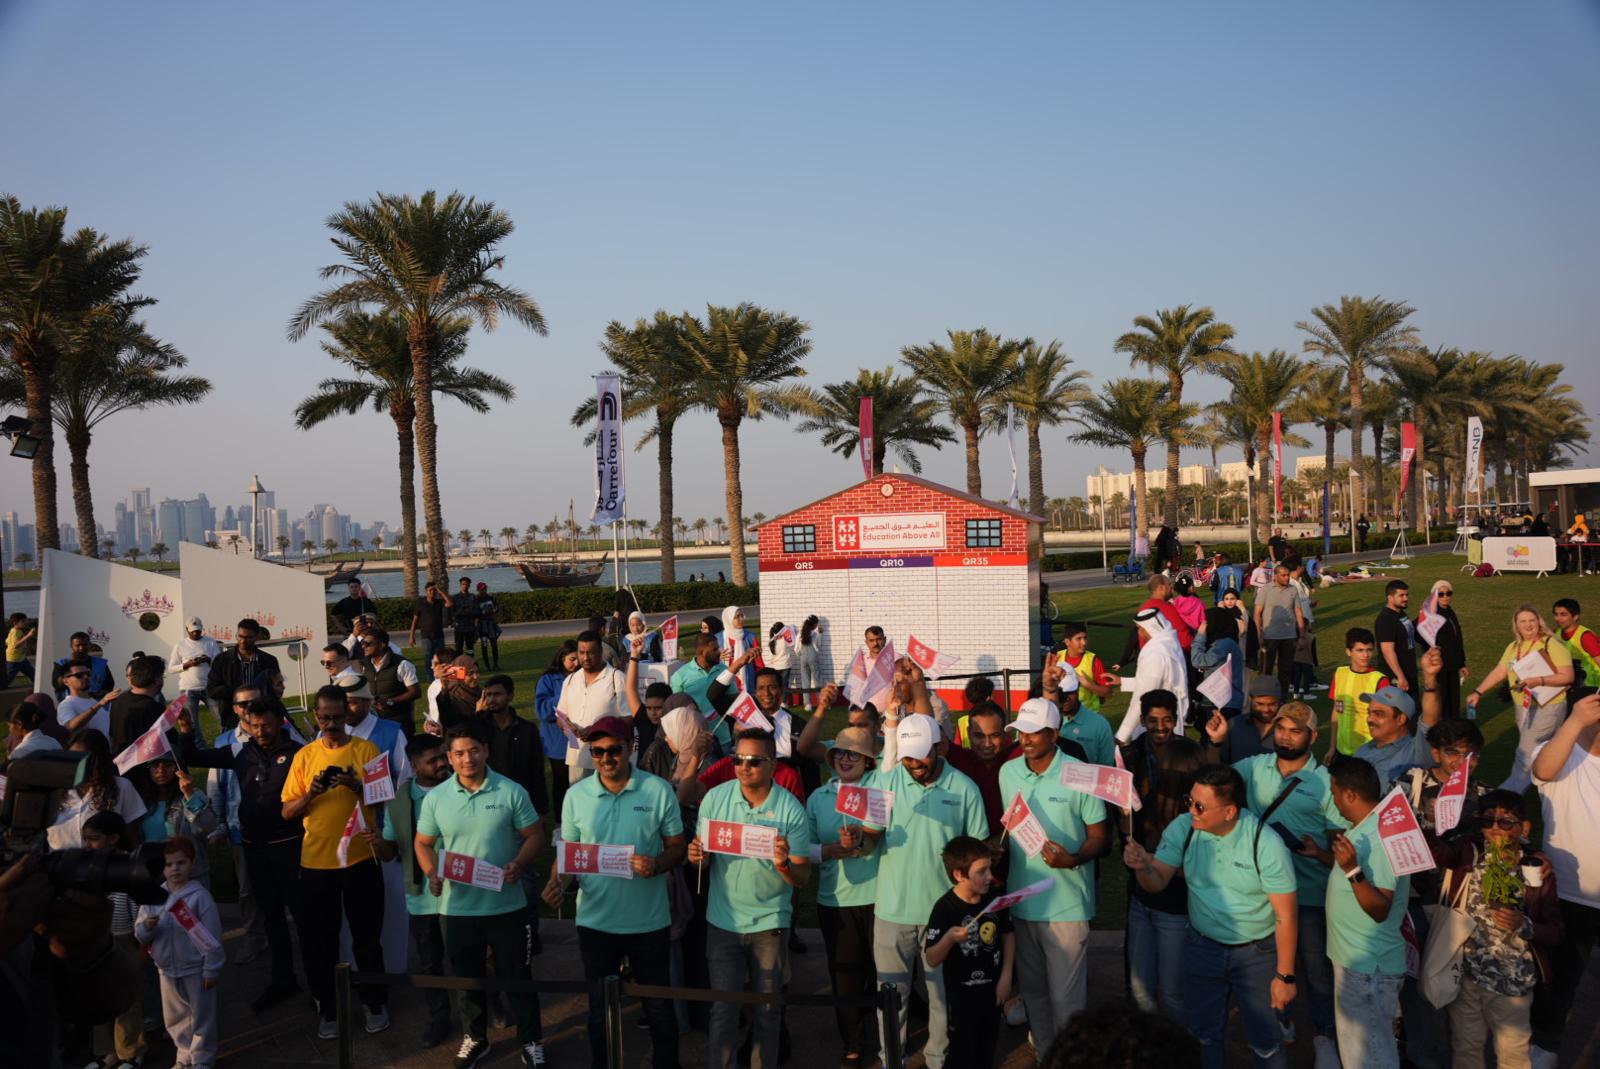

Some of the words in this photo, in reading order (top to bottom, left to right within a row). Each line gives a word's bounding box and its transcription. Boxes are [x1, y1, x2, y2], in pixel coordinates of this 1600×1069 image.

[605, 429, 618, 511] Carrefour
[863, 532, 901, 541] Education
[880, 559, 904, 567] QR10
[962, 557, 989, 565] QR35
[795, 562, 814, 570] QR5
